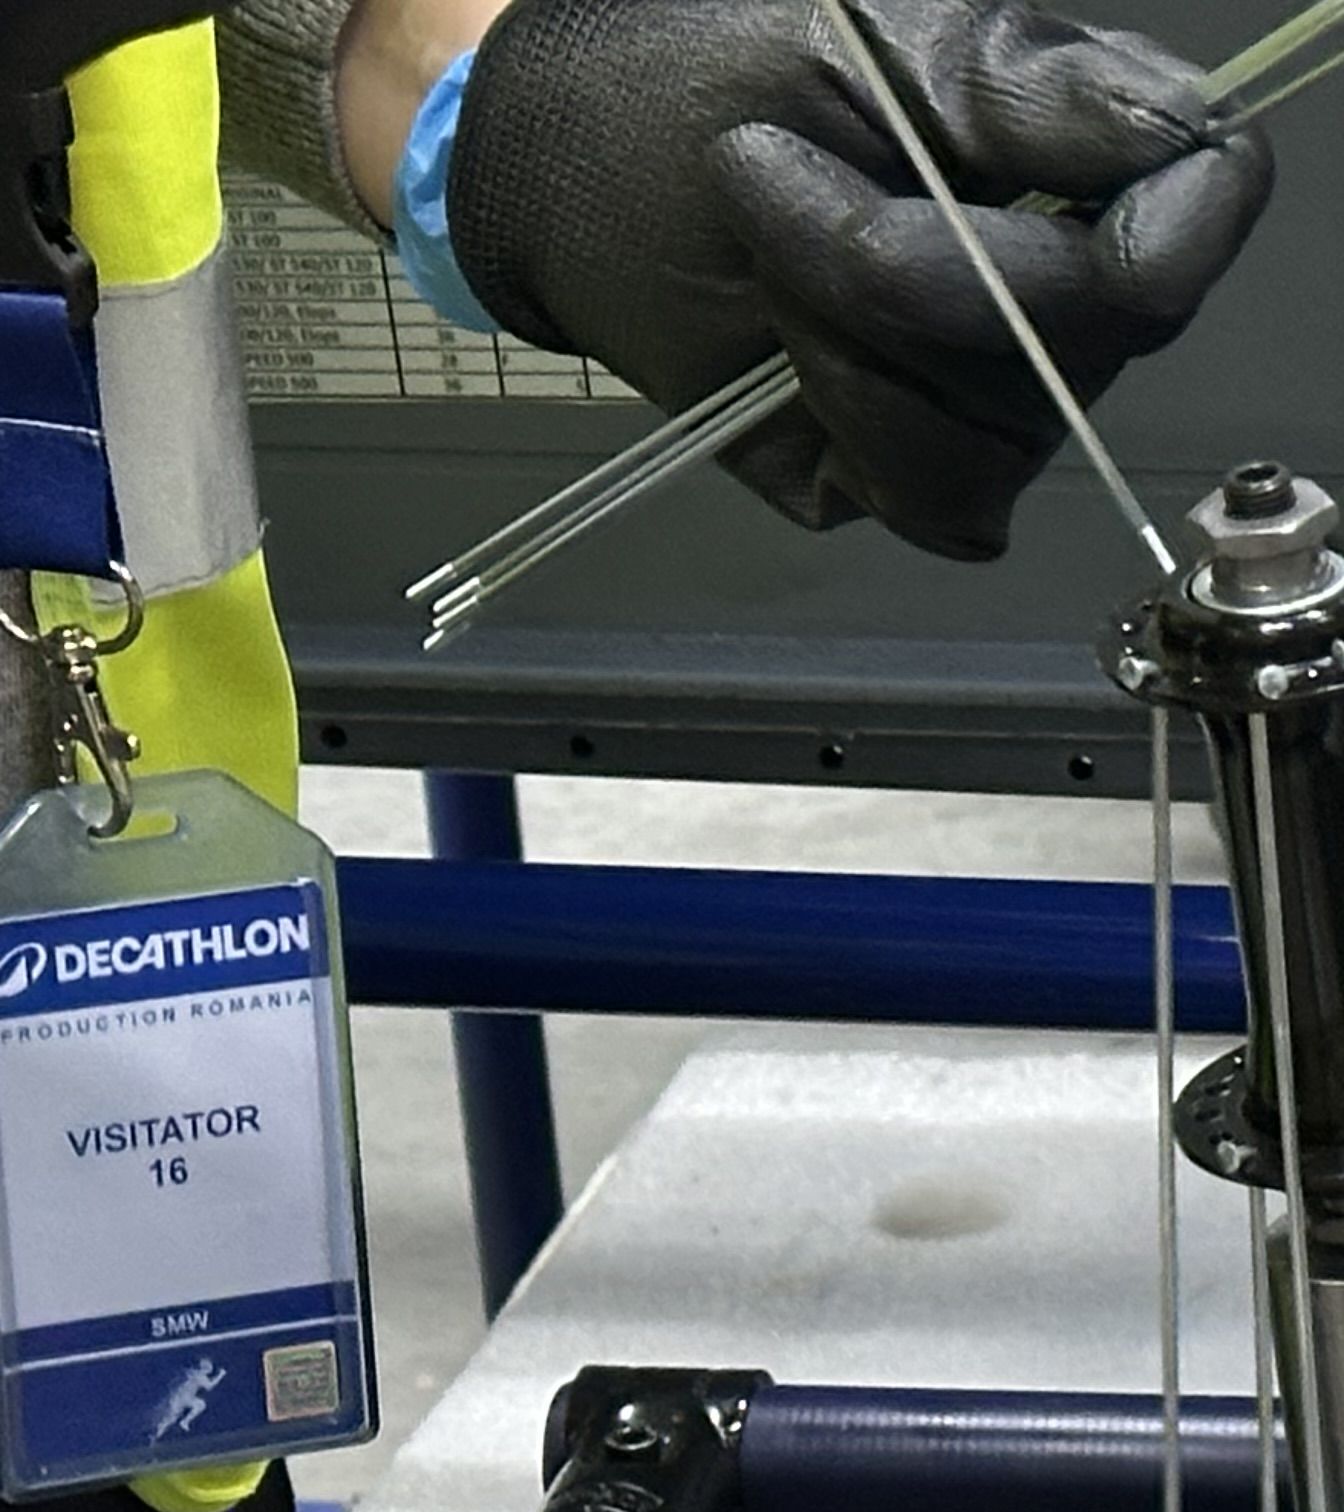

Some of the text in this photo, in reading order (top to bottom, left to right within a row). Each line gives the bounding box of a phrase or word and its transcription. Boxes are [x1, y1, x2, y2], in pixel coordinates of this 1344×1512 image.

[54, 913, 311, 985] DECATHLON
[0, 987, 312, 1046] PRODUCTION ROMANIA
[66, 1103, 261, 1159] VISITATOR
[149, 1157, 189, 1188] 16
[151, 1310, 210, 1339] SMW
